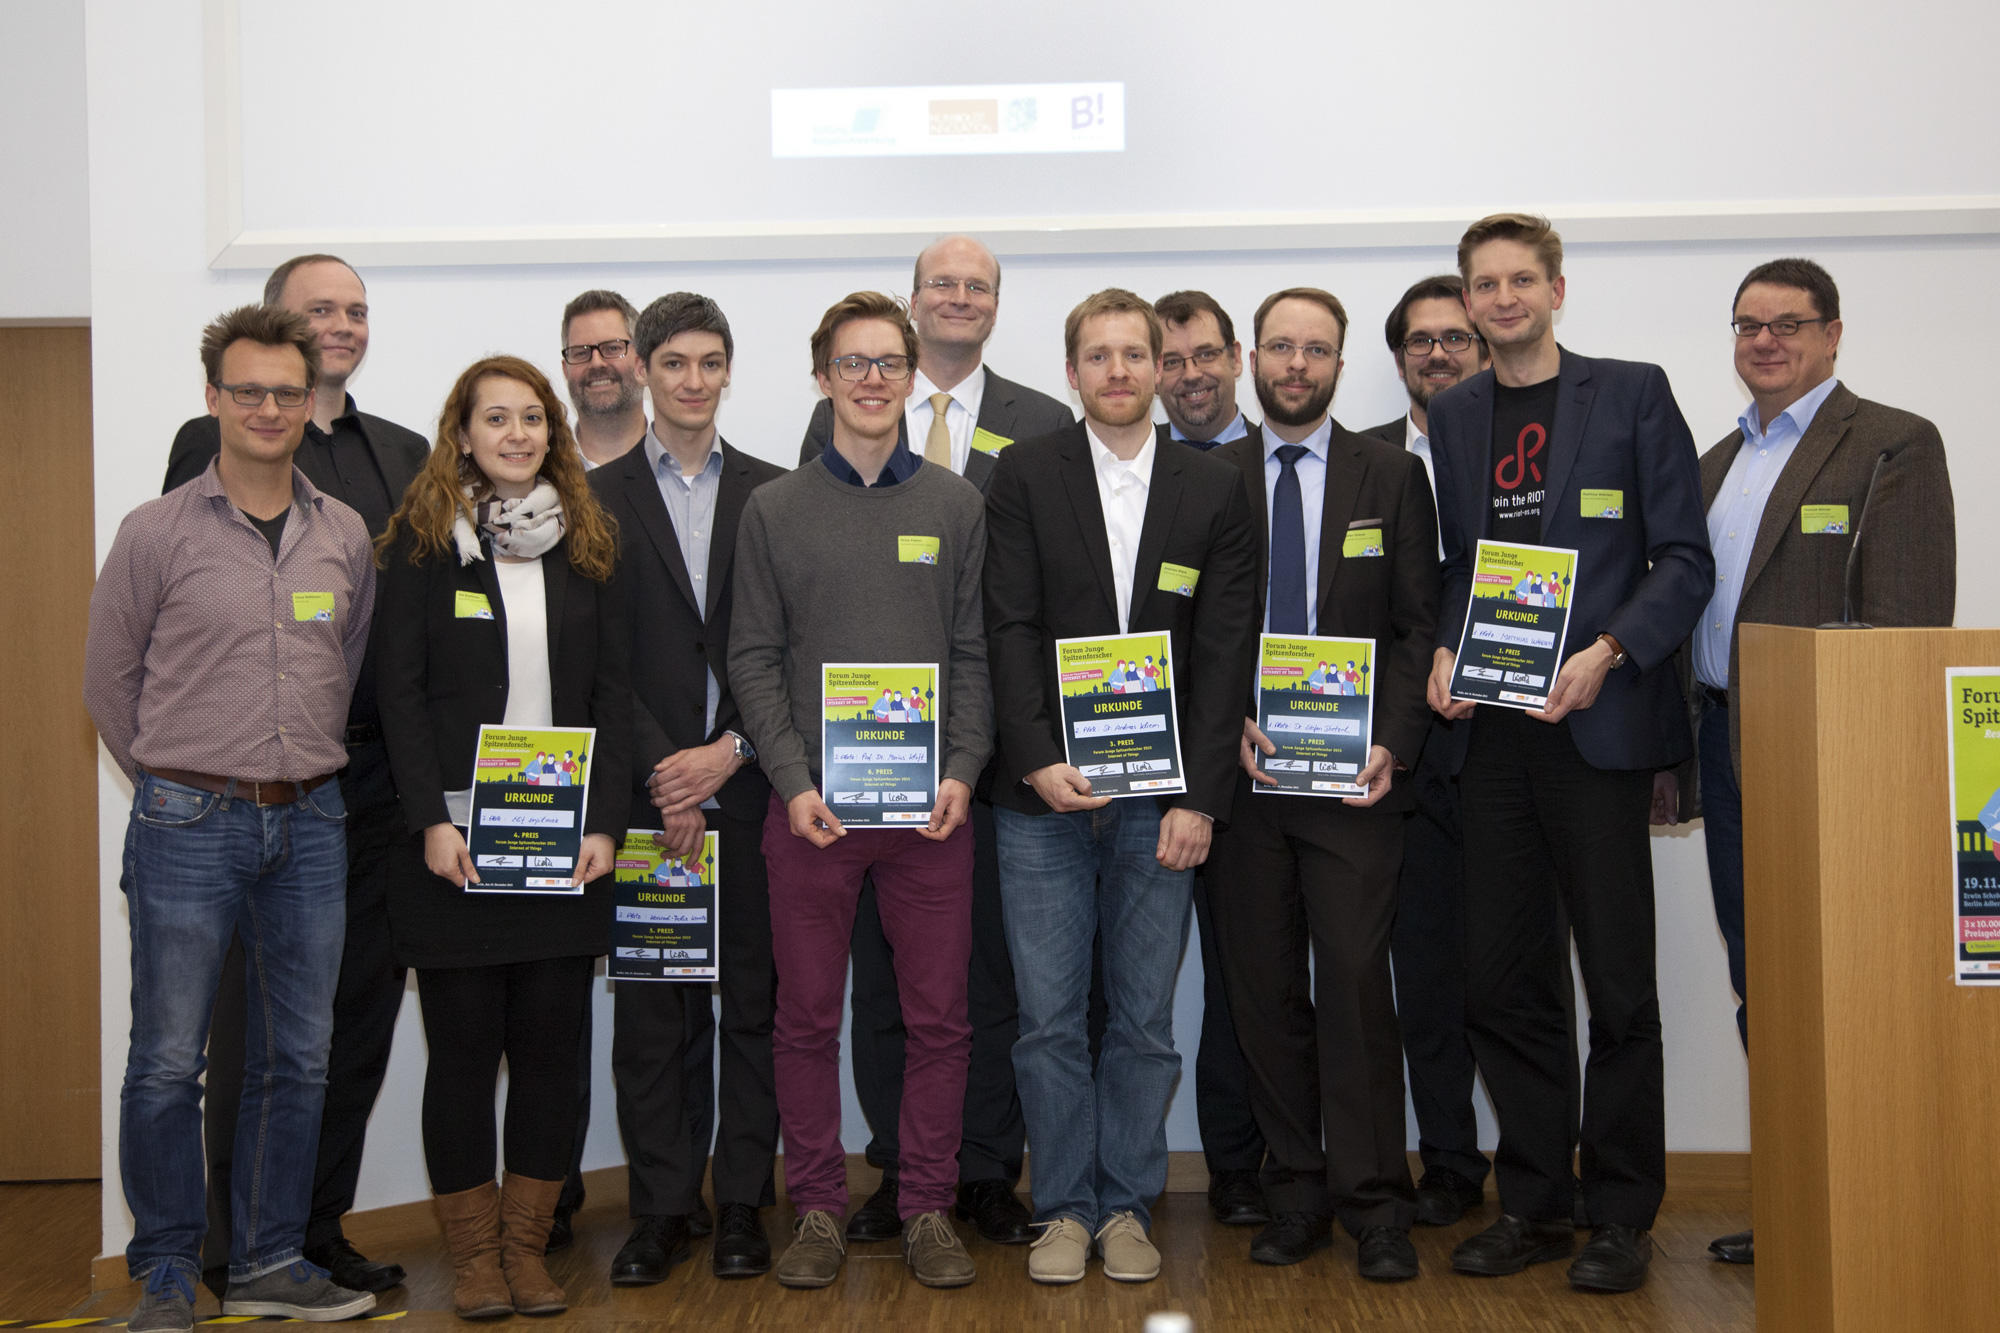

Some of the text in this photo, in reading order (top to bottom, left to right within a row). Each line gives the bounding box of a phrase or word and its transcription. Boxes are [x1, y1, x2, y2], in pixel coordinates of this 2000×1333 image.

[1071, 93, 1105, 130] B!
[1512, 494, 1526, 506] the
[1527, 490, 1545, 504] RIOT
[1481, 549, 1518, 560] Forum Junge
[1481, 556, 1524, 567] Spitzenforscher
[1495, 609, 1539, 624] URKUNDE
[1288, 643, 1308, 651] Junge
[1505, 648, 1520, 656] PREIS
[1063, 652, 1112, 662] Spitzenforscher
[1265, 649, 1315, 657] Spitzenforscher
[852, 672, 871, 680] Junge
[1094, 700, 1143, 714] URKUNDE
[1290, 700, 1339, 712] URKUNDE
[856, 730, 905, 741] URKUNDE
[484, 740, 535, 748] Spitzenforscher
[1117, 739, 1134, 747] PREIS
[505, 792, 554, 804] URKUNDE
[637, 892, 686, 903] URKUNDE
